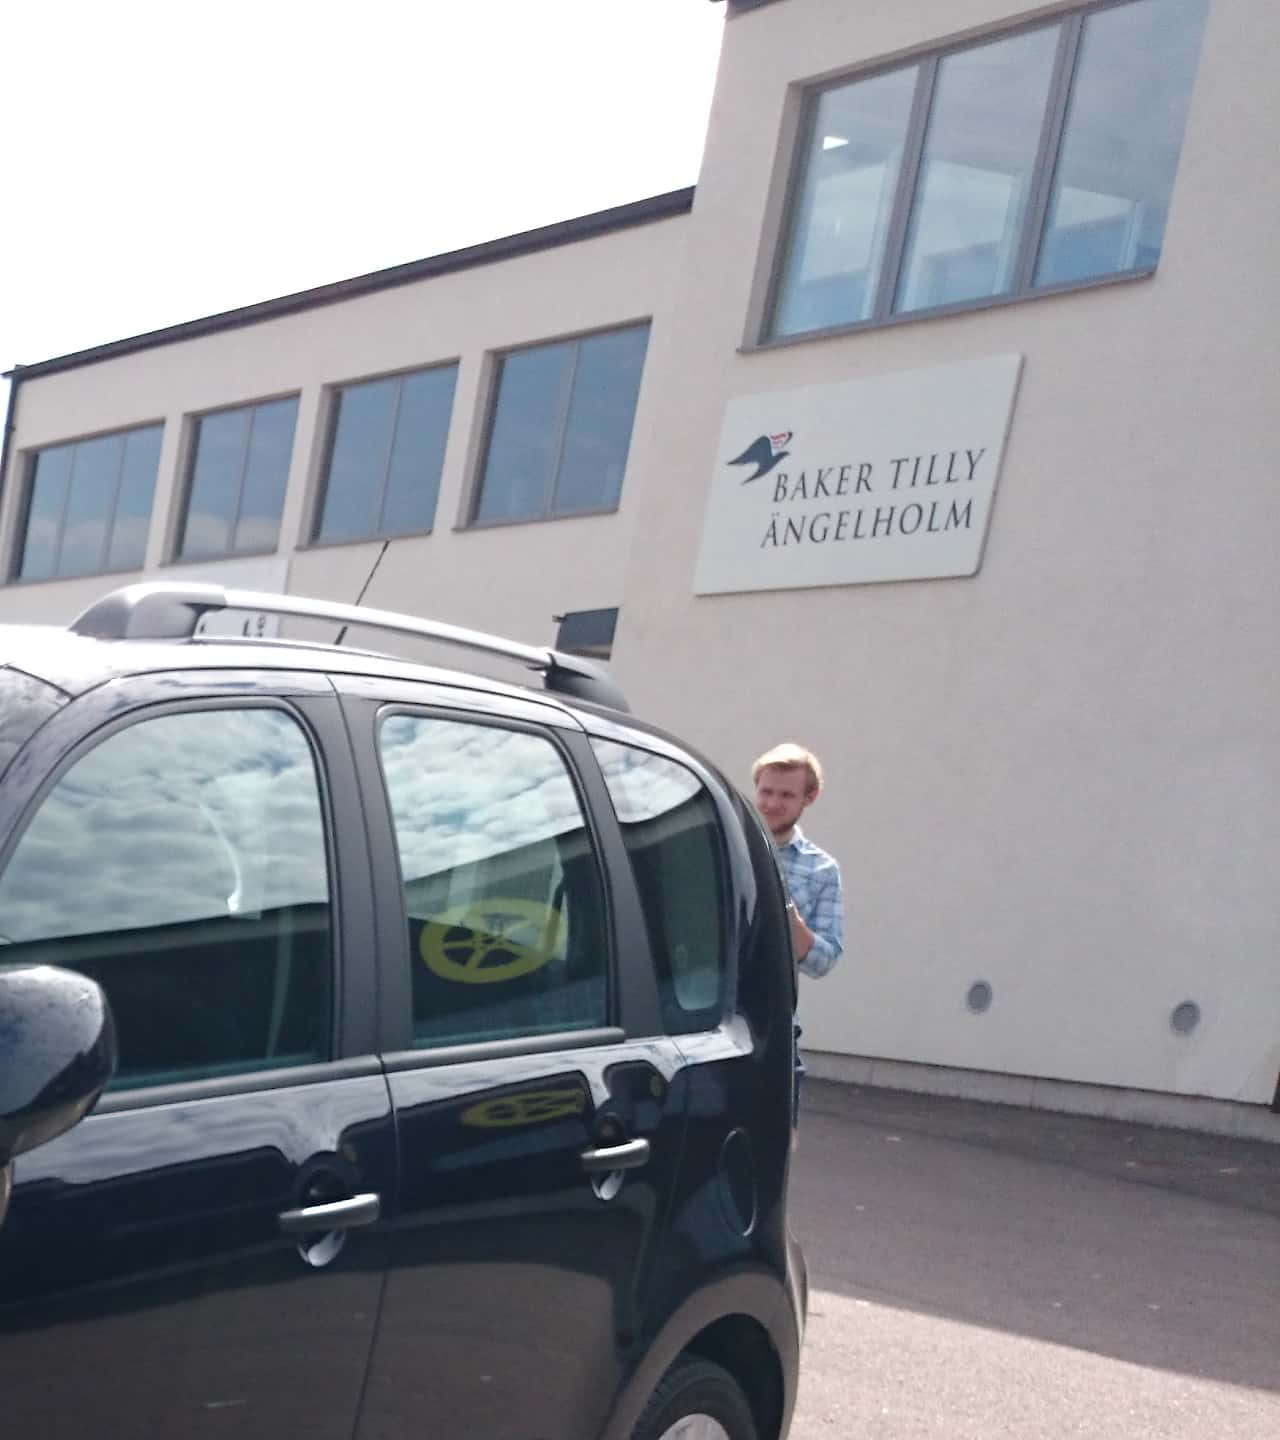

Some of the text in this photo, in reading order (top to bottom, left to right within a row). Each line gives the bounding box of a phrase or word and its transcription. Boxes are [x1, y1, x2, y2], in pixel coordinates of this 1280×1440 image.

[772, 448, 986, 502] BAKER TILLY
[760, 499, 973, 549] ÄNGELHOLM
